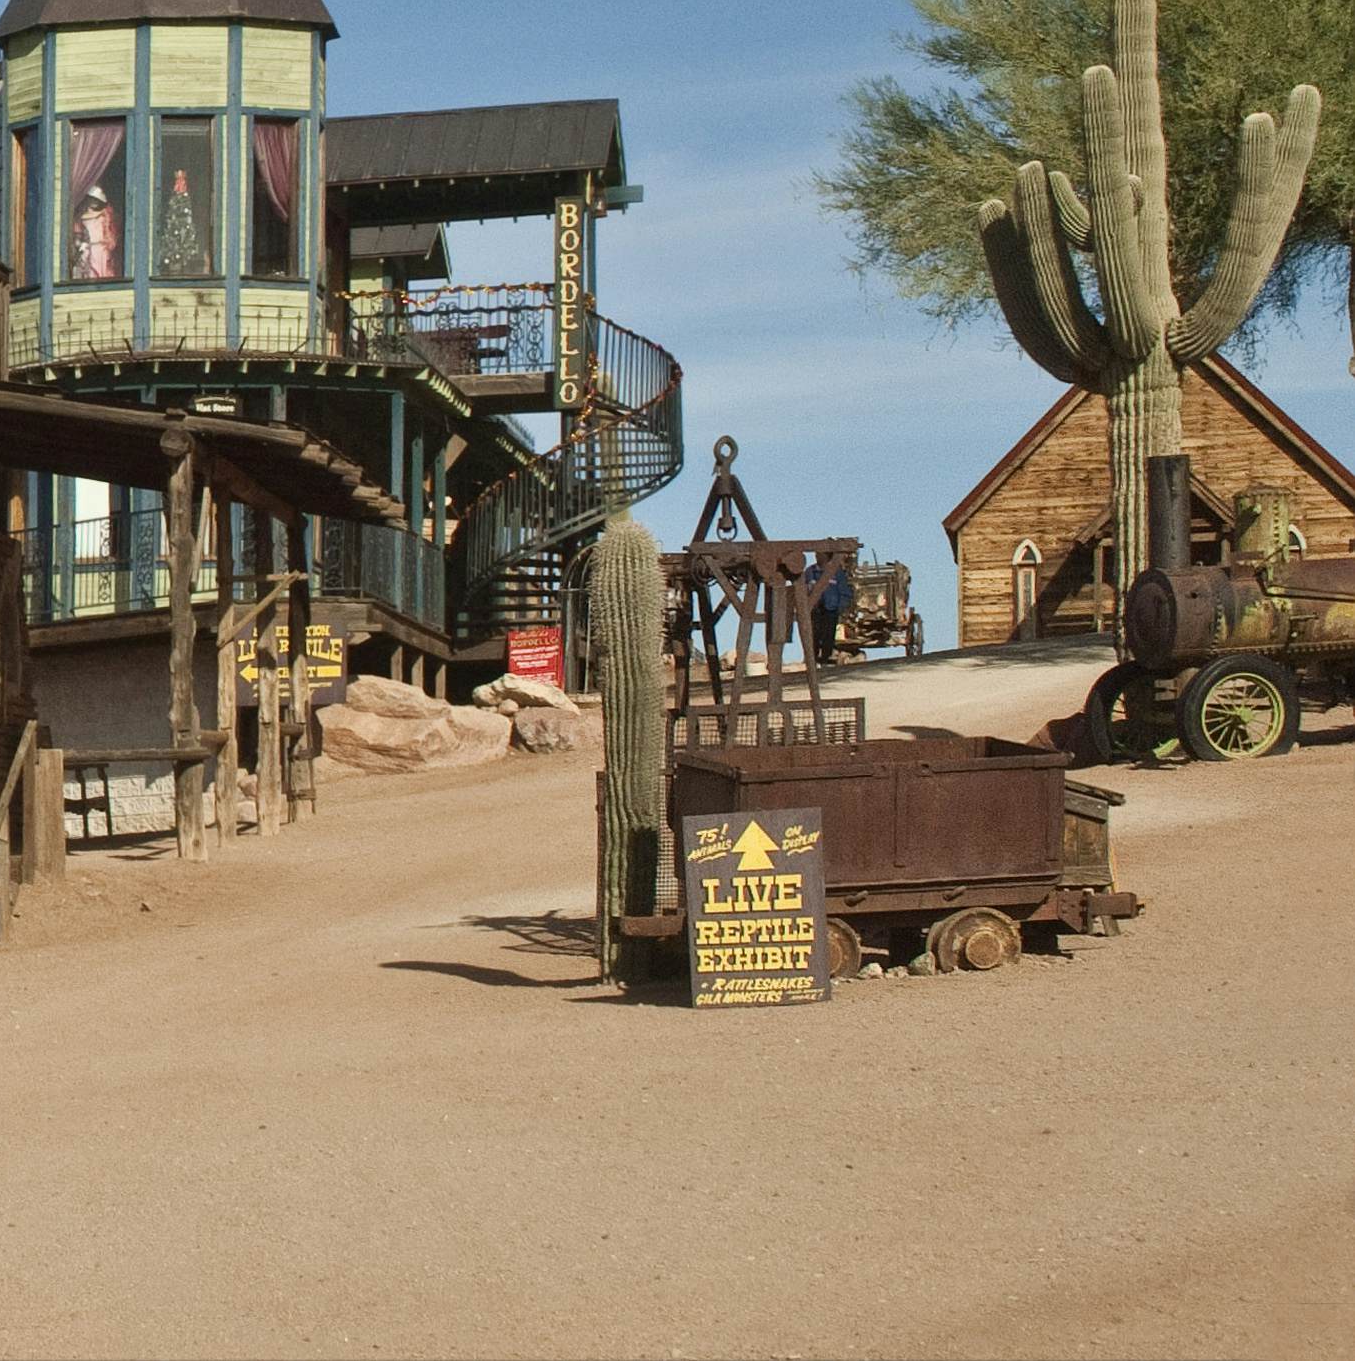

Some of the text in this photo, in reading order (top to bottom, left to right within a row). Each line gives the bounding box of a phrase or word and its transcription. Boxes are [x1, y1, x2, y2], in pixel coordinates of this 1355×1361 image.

[560, 203, 580, 404] BORDELLO
[782, 831, 820, 850] DISPLAY
[785, 825, 803, 839] ON
[688, 838, 732, 862] ANIMALS
[702, 874, 803, 913] LIVE
[695, 916, 815, 945] REPTILE
[696, 945, 812, 973] EXHIBIT
[712, 976, 814, 991] RATTLESNAKES
[723, 990, 783, 1004] MONSTERS
